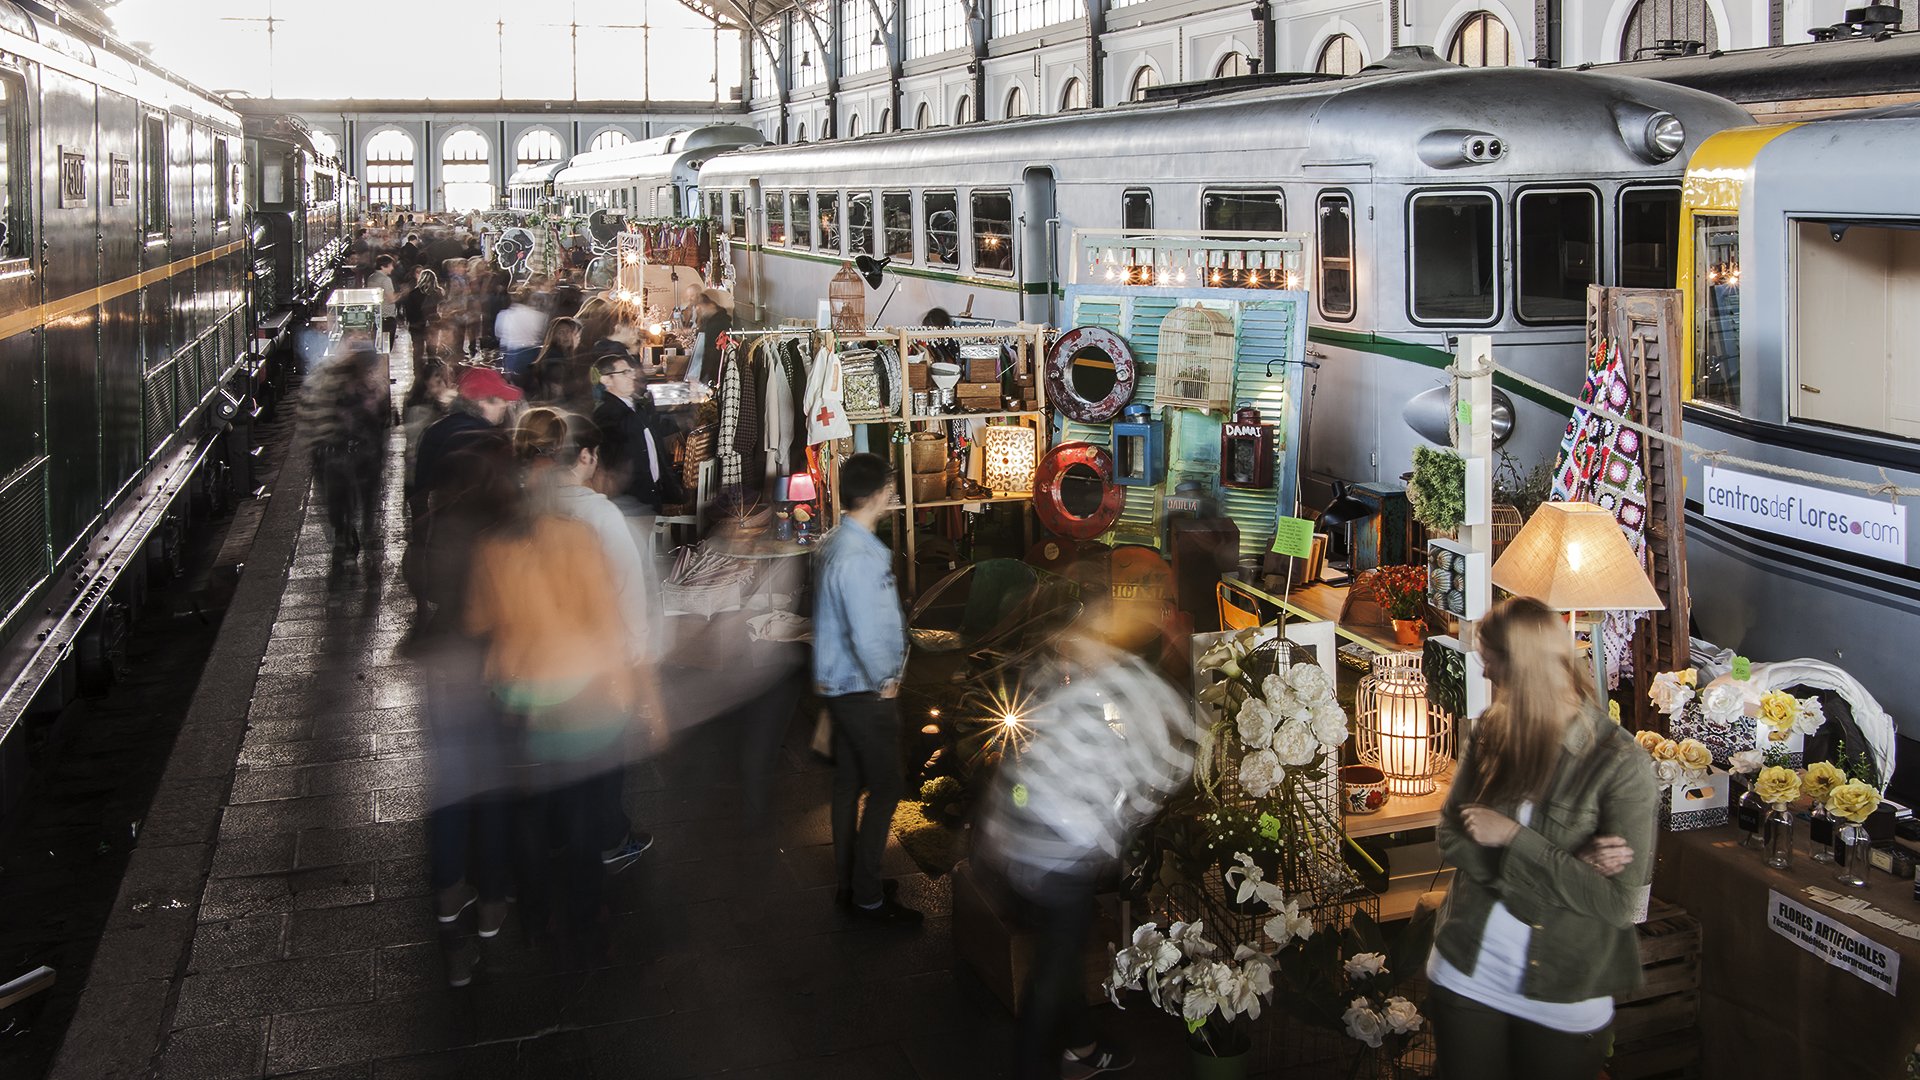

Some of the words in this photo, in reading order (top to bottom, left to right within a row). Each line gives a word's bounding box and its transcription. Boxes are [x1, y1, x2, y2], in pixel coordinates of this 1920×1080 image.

[64, 159, 86, 196] 7507
[1087, 249, 1169, 268] CALMA
[1193, 249, 1300, 270] CHECHU
[1778, 902, 1814, 932] FLORES
[1814, 920, 1887, 969] ARTIFICIALES
[1828, 946, 1837, 958] Te
